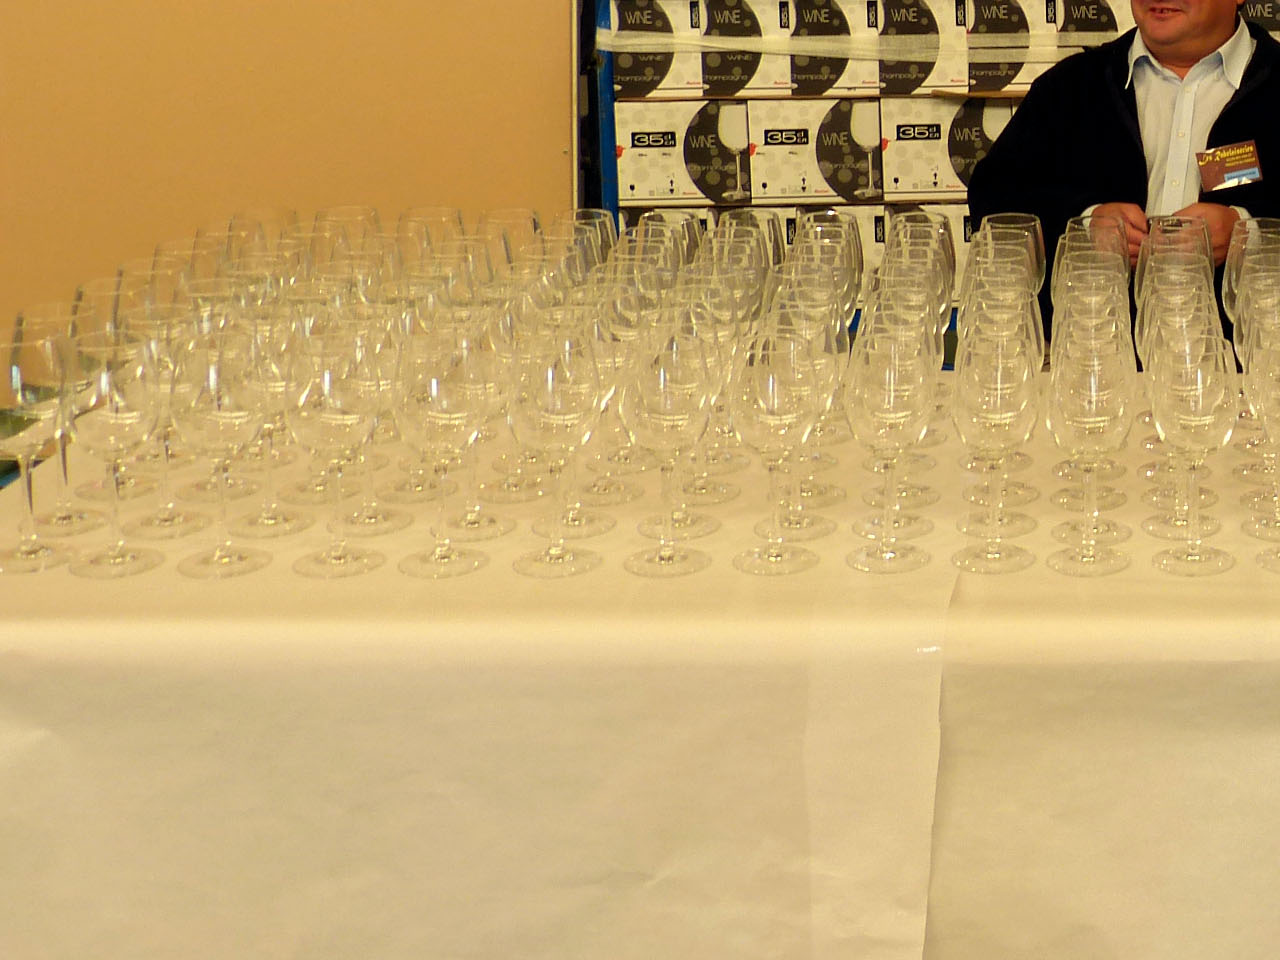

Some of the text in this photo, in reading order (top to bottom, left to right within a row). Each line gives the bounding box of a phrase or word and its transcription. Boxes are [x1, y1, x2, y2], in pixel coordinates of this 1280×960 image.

[625, 10, 653, 25] WINE
[714, 9, 741, 24] WINE
[803, 9, 830, 23] WINE
[891, 8, 919, 23] WINE
[982, 5, 1008, 19] WINE
[1071, 5, 1098, 19] WINE
[1247, 3, 1273, 18] WINE
[690, 134, 716, 148] WINE
[822, 132, 849, 146] WINE
[954, 127, 981, 141] WINE
